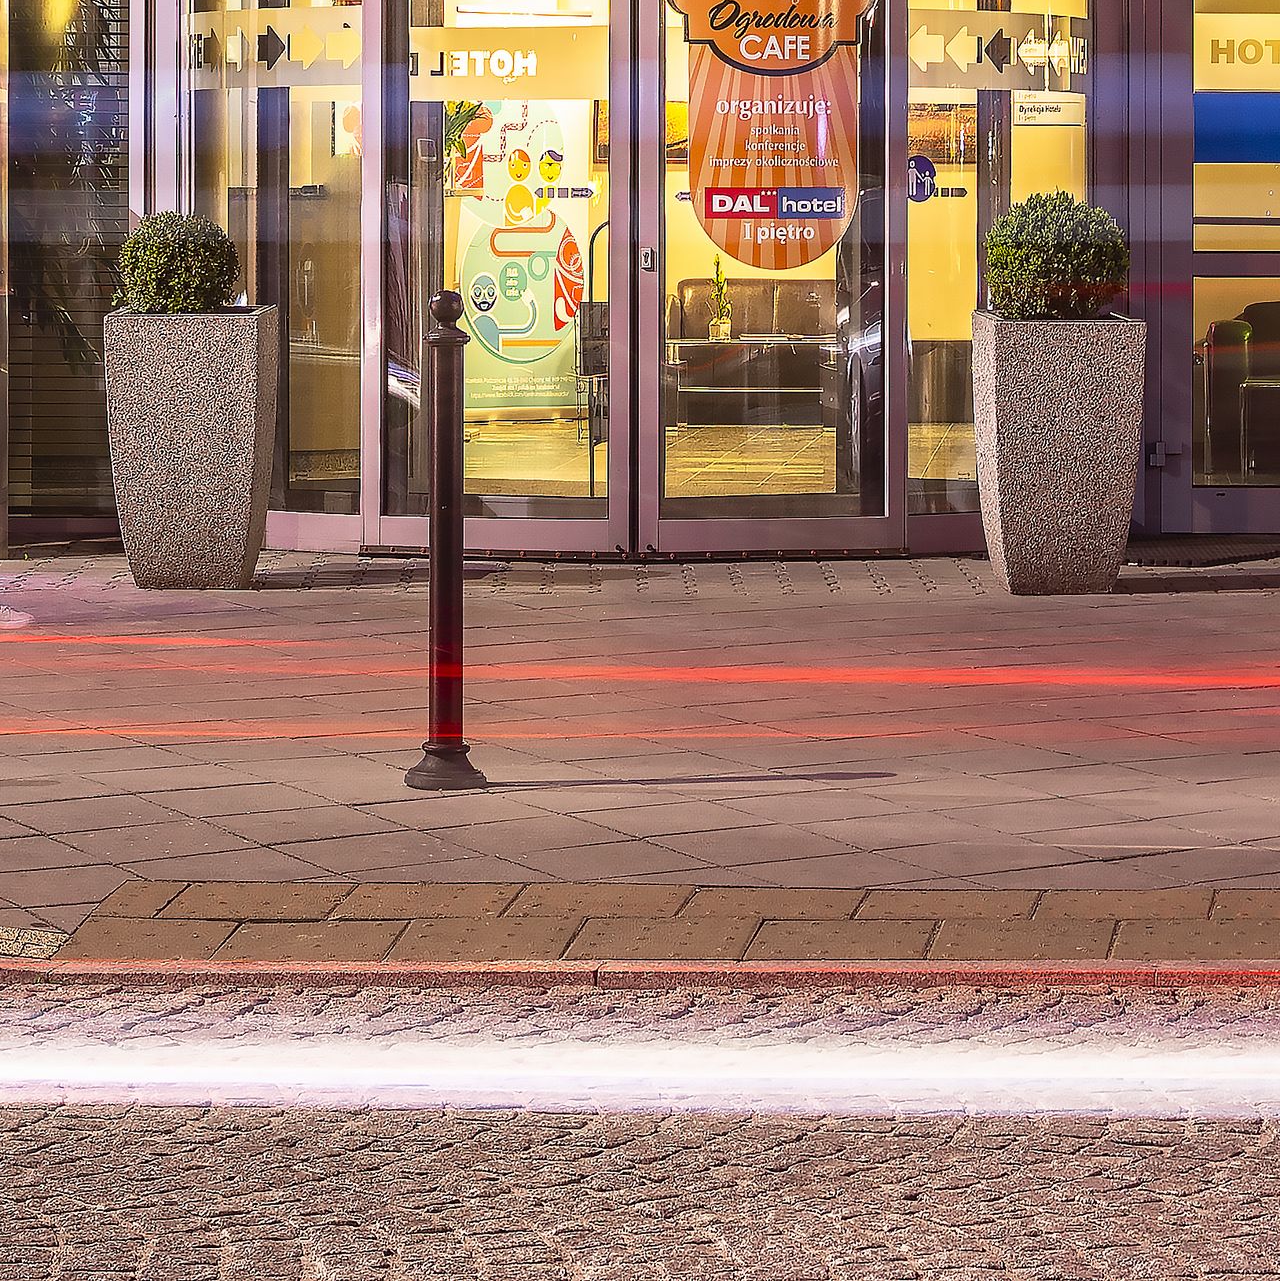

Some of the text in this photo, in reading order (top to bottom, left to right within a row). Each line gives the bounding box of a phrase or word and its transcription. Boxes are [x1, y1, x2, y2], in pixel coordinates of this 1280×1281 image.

[738, 35, 810, 60] CAFE
[716, 94, 832, 120] organizuje:
[750, 124, 800, 138] spotkania
[745, 140, 806, 153] konferencje
[709, 155, 839, 169] imprezy okolicznościowe
[712, 194, 842, 213] DAL hotel
[743, 221, 816, 245] I piętro
